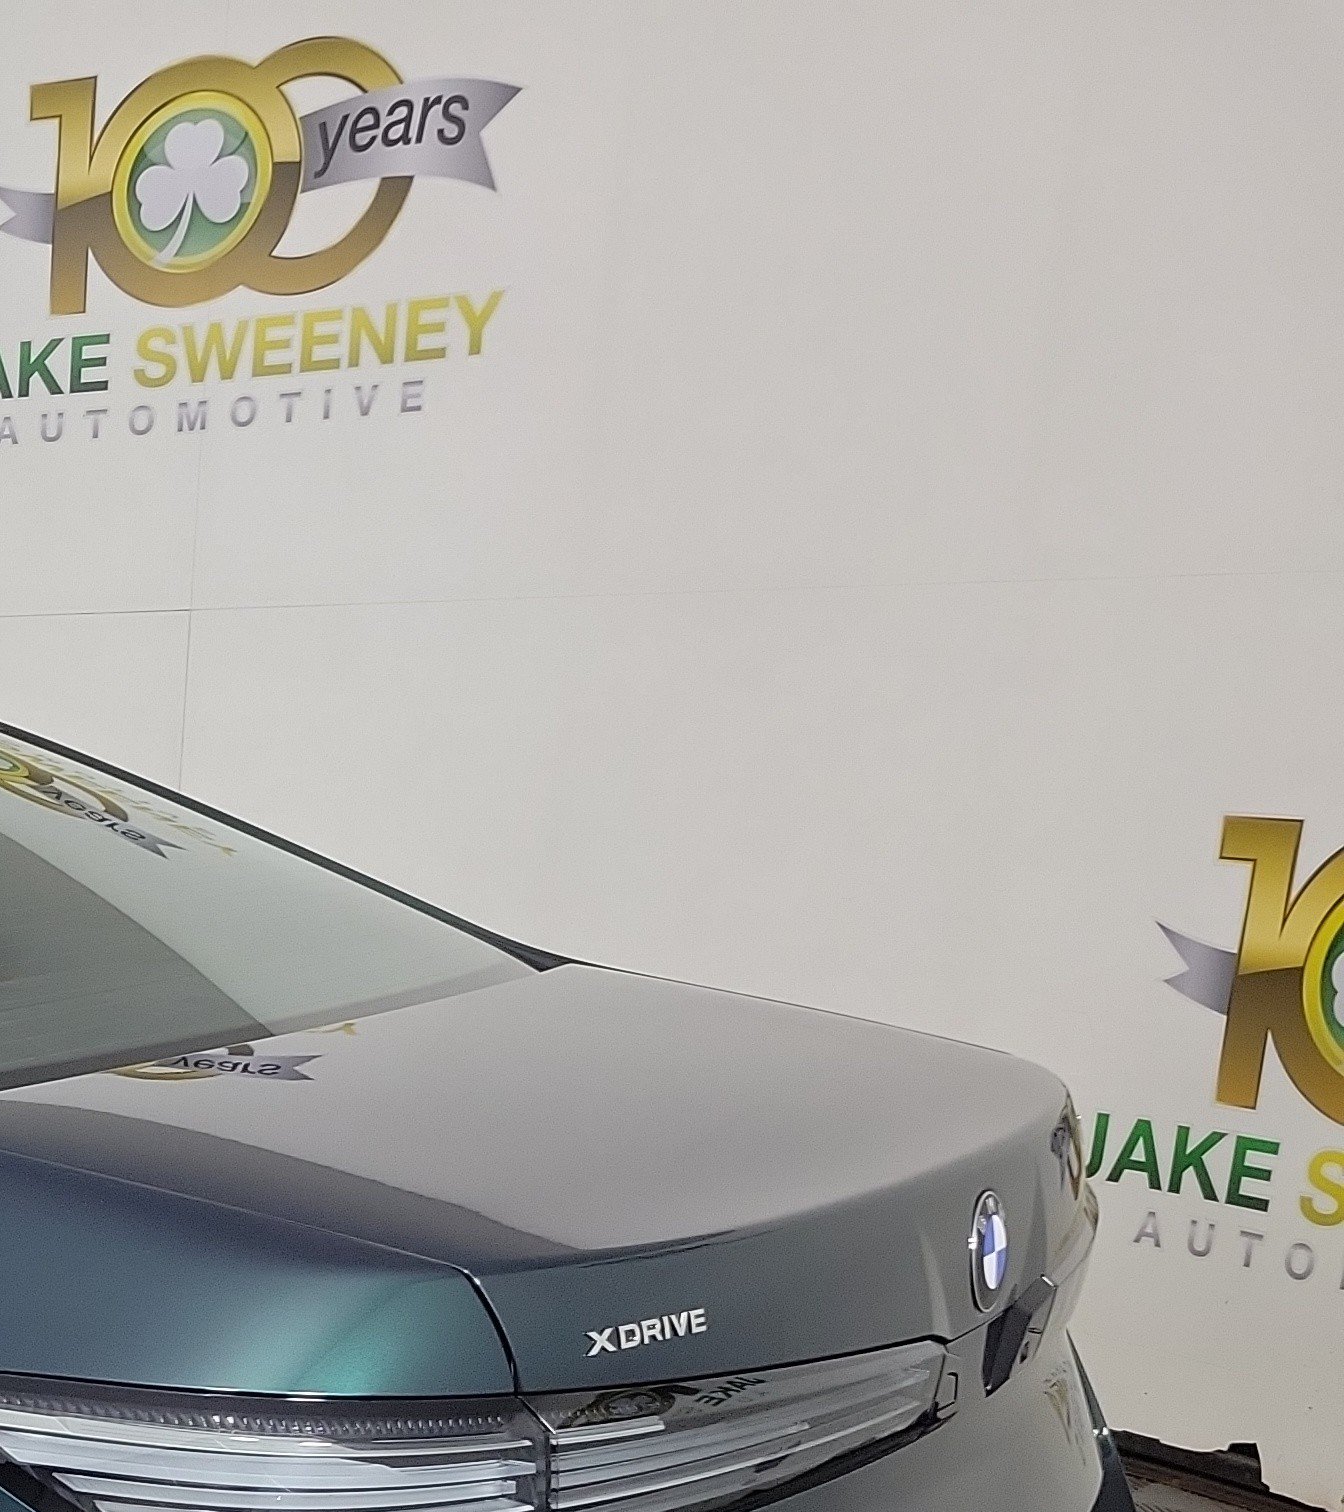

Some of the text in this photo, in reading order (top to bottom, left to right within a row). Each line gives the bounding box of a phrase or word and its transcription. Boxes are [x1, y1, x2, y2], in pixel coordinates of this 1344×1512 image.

[314, 91, 470, 180] years
[132, 289, 506, 389] SWEENEY
[1084, 1111, 1280, 1213] JAKE
[1132, 1209, 1344, 1291] AUTO
